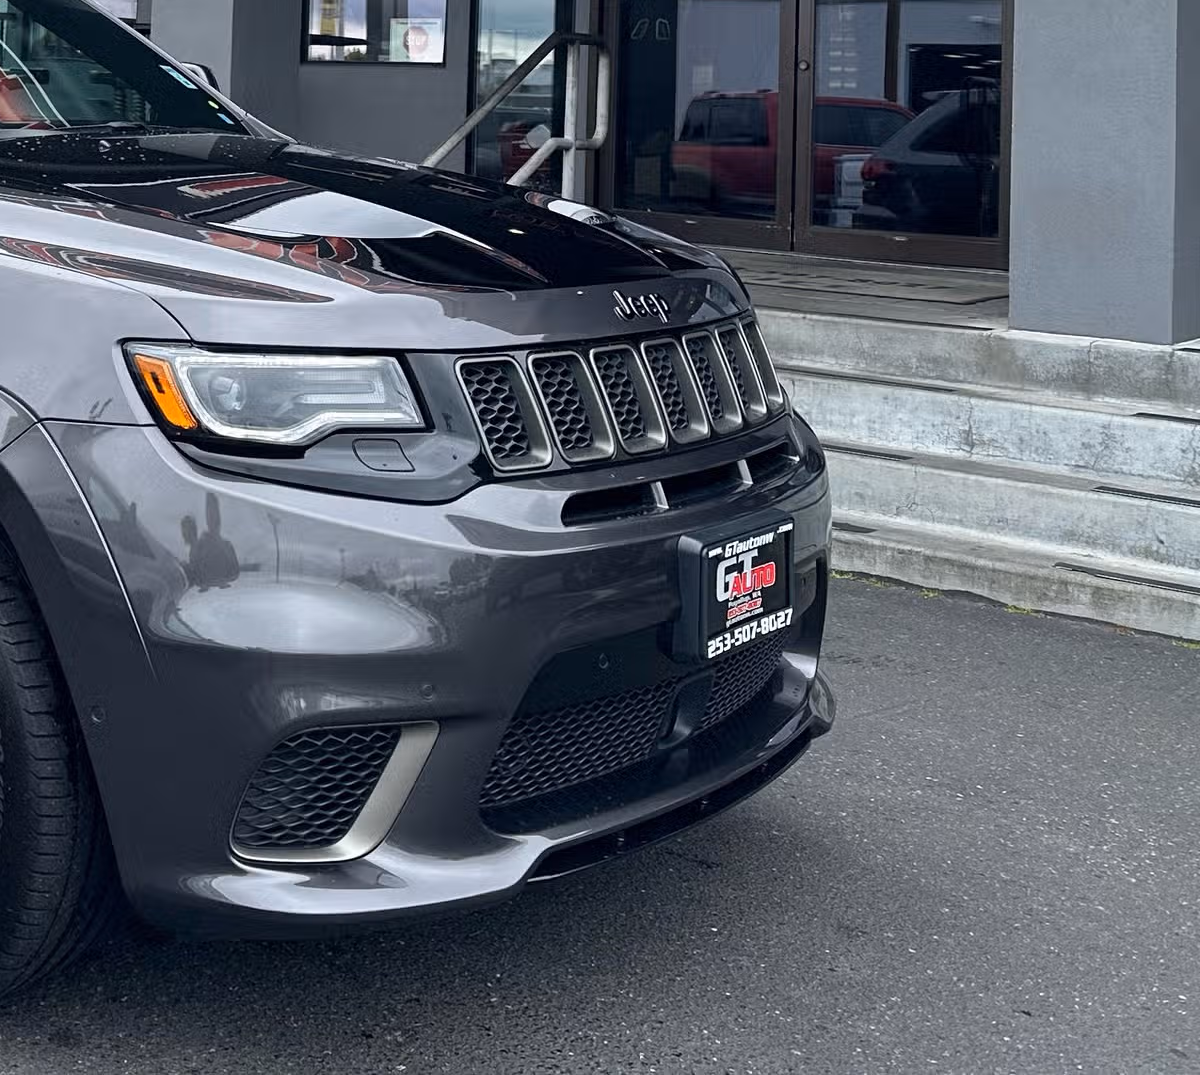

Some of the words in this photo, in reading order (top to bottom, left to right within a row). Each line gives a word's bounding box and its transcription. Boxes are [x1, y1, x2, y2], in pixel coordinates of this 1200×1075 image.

[612, 290, 669, 323] Jeep
[716, 548, 759, 602] GT
[729, 561, 776, 601] AUTO
[707, 608, 793, 659] 253-507-8027
